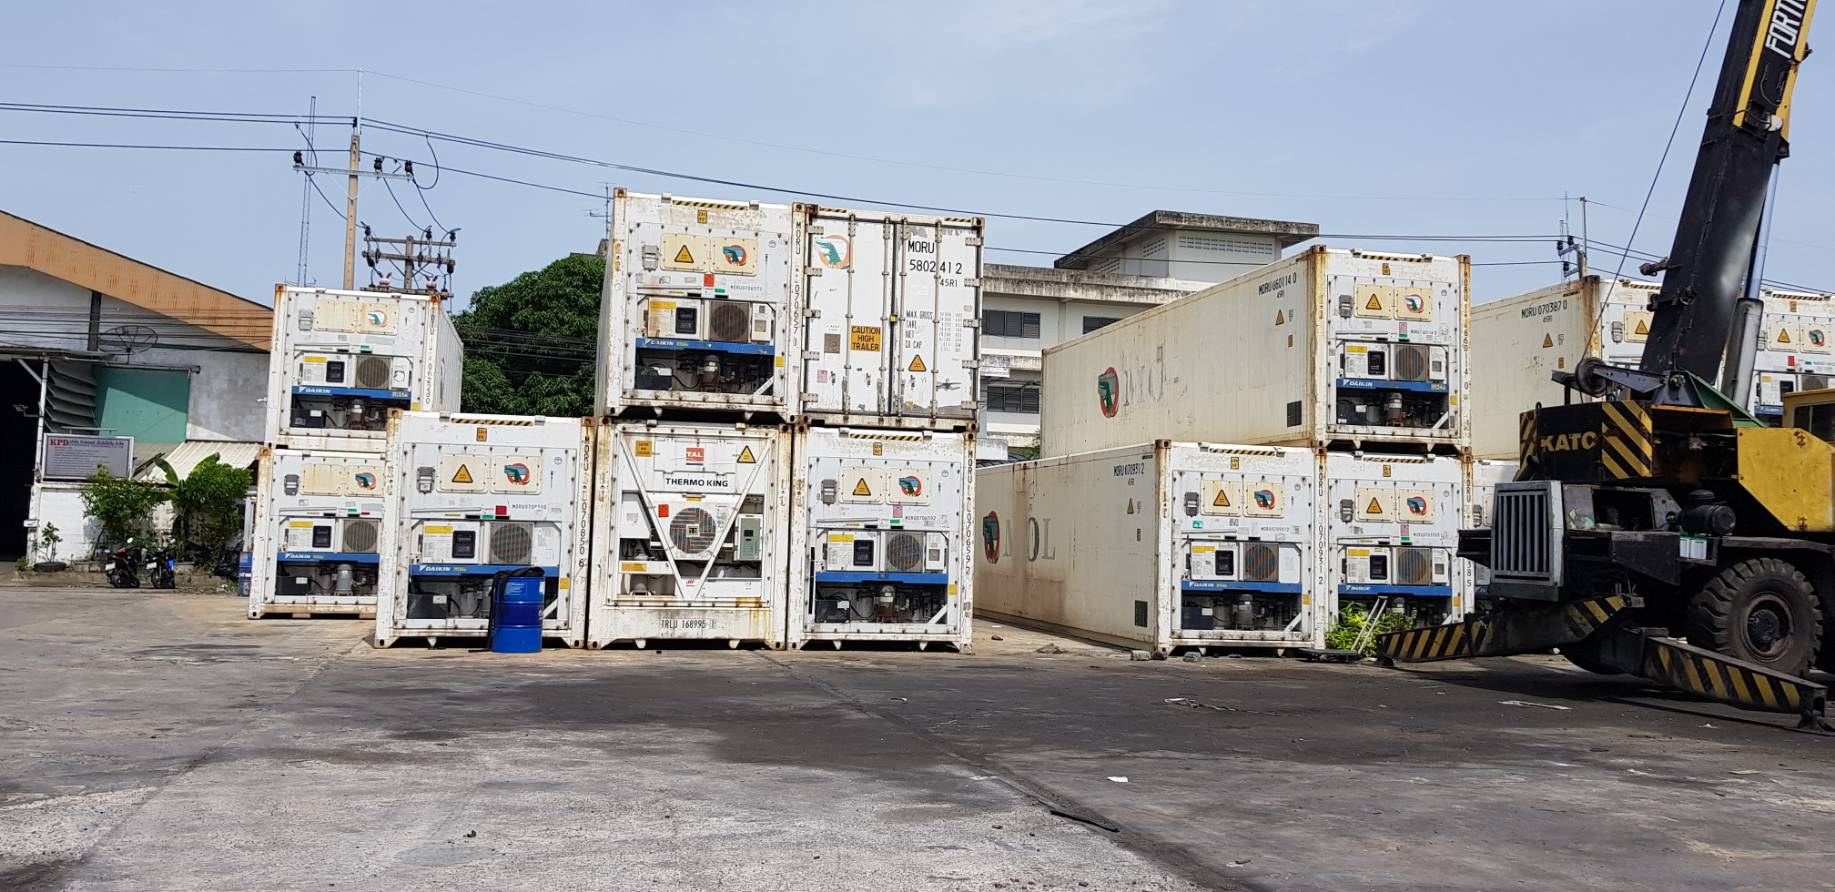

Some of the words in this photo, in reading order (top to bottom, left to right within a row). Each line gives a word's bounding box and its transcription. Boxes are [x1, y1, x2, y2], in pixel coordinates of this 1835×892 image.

[908, 239, 935, 254] MORU
[940, 278, 958, 288] 45R1
[905, 310, 918, 319] MAX
[851, 325, 881, 335] CAUTION
[857, 334, 875, 343] HIGH
[851, 343, 880, 352] TRAILER
[665, 477, 705, 487] THERMO
[706, 479, 729, 488] KING
[660, 619, 678, 629] TRLU
